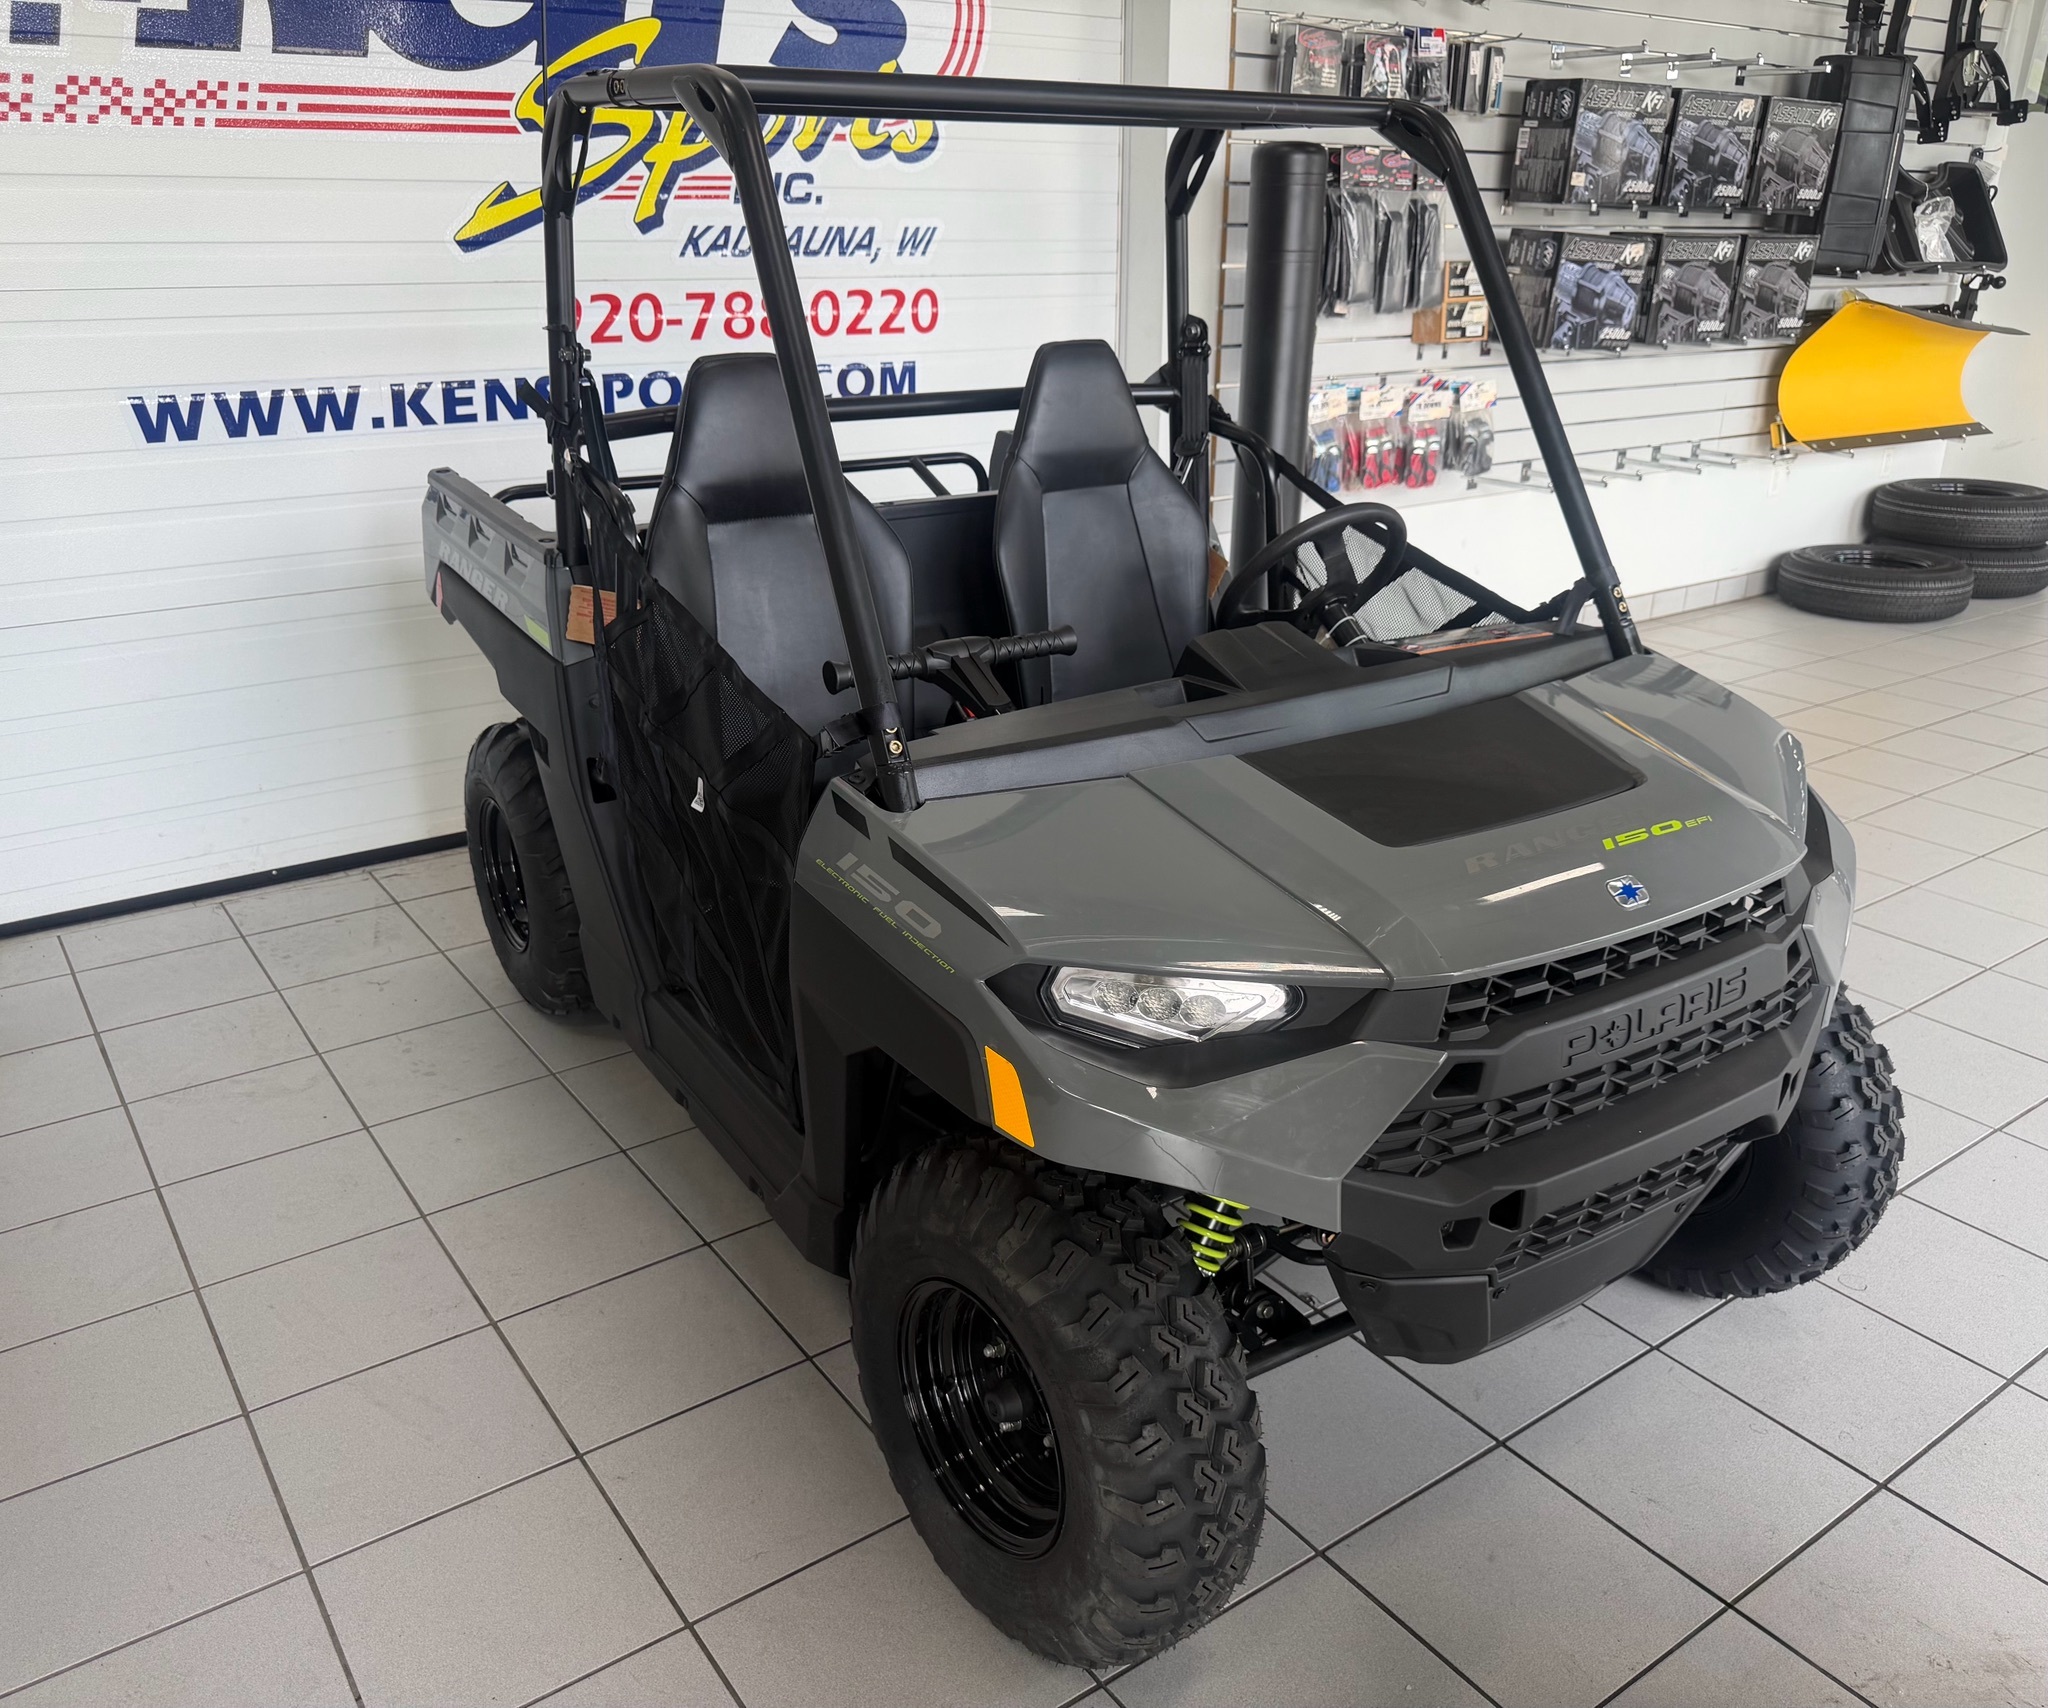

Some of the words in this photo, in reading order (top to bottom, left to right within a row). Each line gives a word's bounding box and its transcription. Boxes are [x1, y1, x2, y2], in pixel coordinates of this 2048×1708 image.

[679, 224, 881, 264] KAUAUNA,
[896, 226, 938, 258] WI
[438, 540, 510, 613] RANGER
[1602, 819, 1683, 851] 150
[1685, 815, 1712, 828] EFI
[815, 858, 870, 904] ELECTRONIC
[872, 906, 898, 929] FUEL
[902, 930, 955, 974] INJECTION
[836, 852, 942, 939] 150
[1562, 966, 1747, 1068] POLARIS
